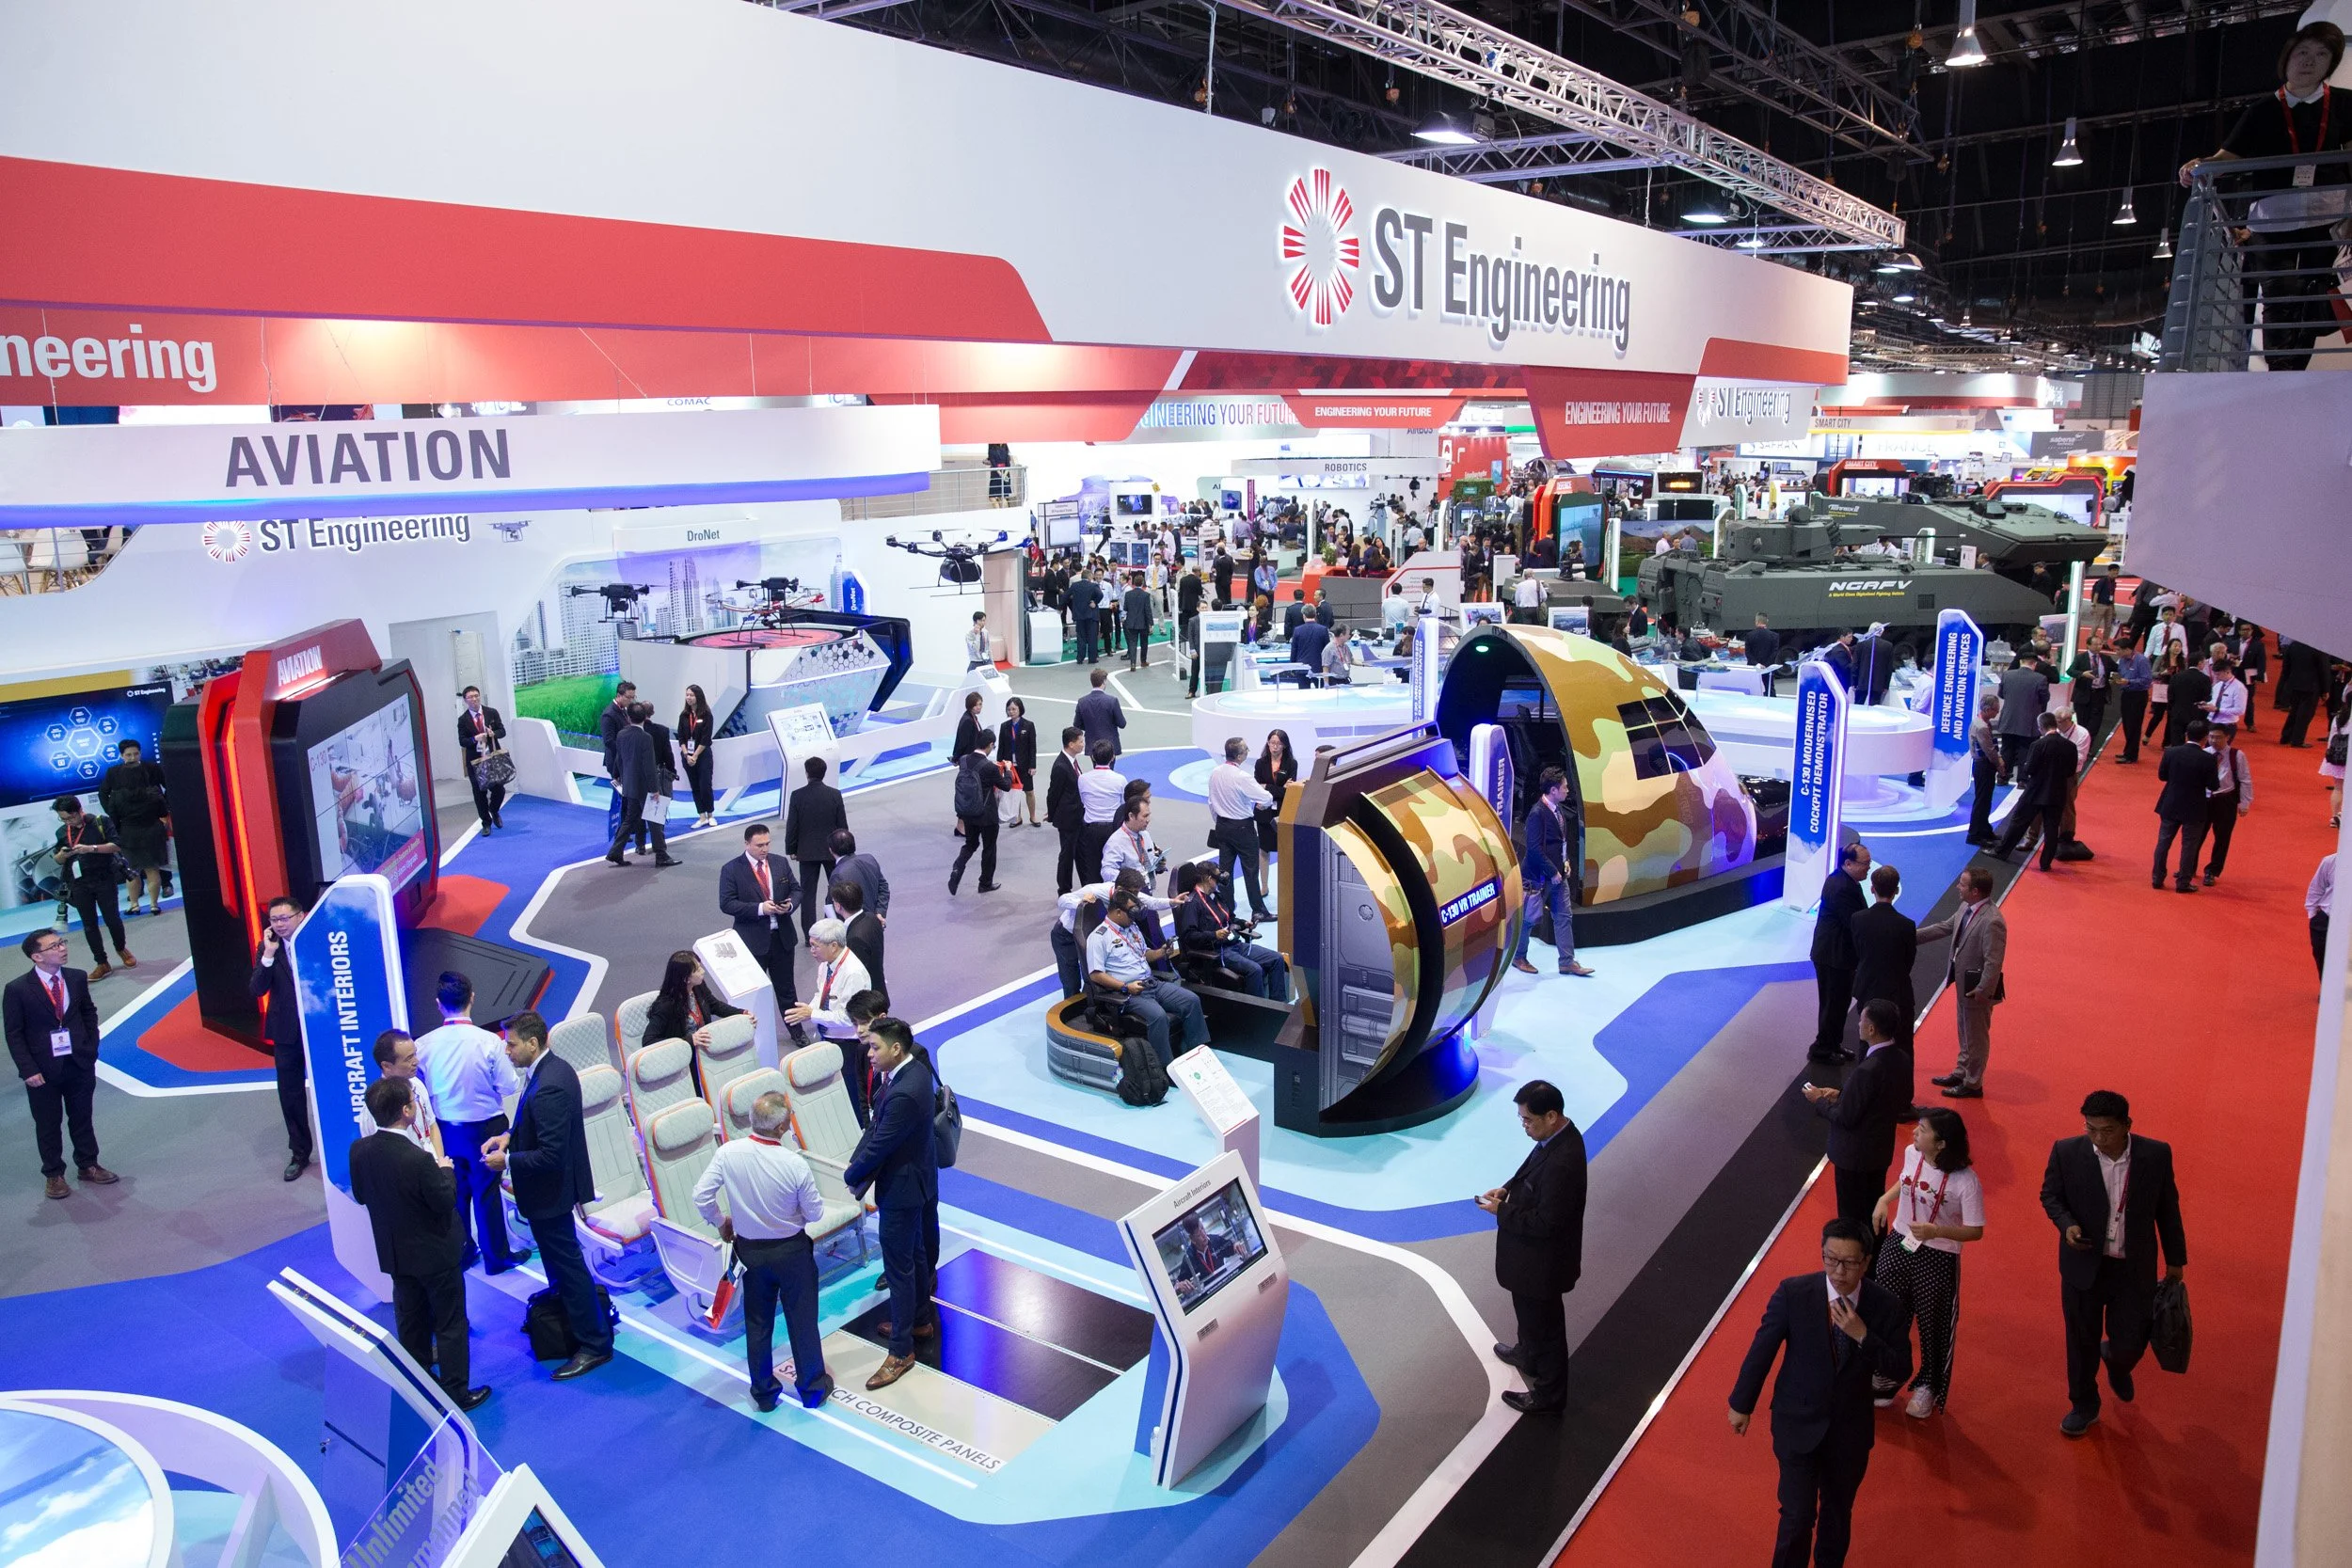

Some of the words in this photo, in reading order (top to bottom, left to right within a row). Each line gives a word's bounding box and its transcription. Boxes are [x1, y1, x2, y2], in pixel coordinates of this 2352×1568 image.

[1375, 207, 1433, 310] ST
[1445, 221, 1630, 352] Engineering
[667, 397, 711, 406] COMAC
[1141, 403, 1216, 426] GINEERING
[1220, 404, 1253, 425] YOUR
[1258, 403, 1298, 425] FUTUR
[1315, 406, 1372, 417] ENGINEERING
[1374, 406, 1397, 417] YOUR
[1398, 406, 1432, 417] FUTURE
[1565, 401, 1621, 425] ENGINEERING
[1622, 402, 1643, 423] YOUR
[1643, 403, 1671, 423] FUTURE
[1735, 387, 1791, 425] Engineering
[1815, 419, 1836, 428] SMART
[1837, 419, 1851, 428] CITY
[225, 427, 512, 488] AVIATION
[1325, 463, 1367, 472] ROBOTICS
[260, 518, 299, 552] ST
[308, 515, 470, 552] Engineering
[687, 529, 720, 542] DroNet
[1829, 580, 1913, 592] NGAFV
[277, 644, 323, 687] AVIATION
[1944, 632, 1958, 691] ENGINEERING
[1959, 633, 1971, 678] SERVICES
[1940, 693, 1952, 734] DEFENCE
[1955, 679, 1967, 719] AVIATION
[1802, 690, 1816, 762] MODERNISED
[1813, 692, 1829, 785] DEMONSTRATOR
[1952, 719, 1963, 740] AND
[1497, 757, 1505, 816] TRAINER
[1800, 764, 1811, 796] C-130
[1809, 787, 1821, 833] COCKPIT
[1440, 903, 1459, 923] C-130
[1457, 897, 1470, 913] VR
[1468, 882, 1496, 908] TRAINER
[328, 930, 360, 1032] INTERIORS
[342, 1034, 368, 1126] AIRCRAFT
[1173, 1189, 1193, 1209] Aircraft
[1191, 1179, 1212, 1199] Interiors
[855, 1399, 941, 1444] COMPOSITE
[940, 1438, 1001, 1470] PANELS
[407, 1467, 484, 1568] manned
